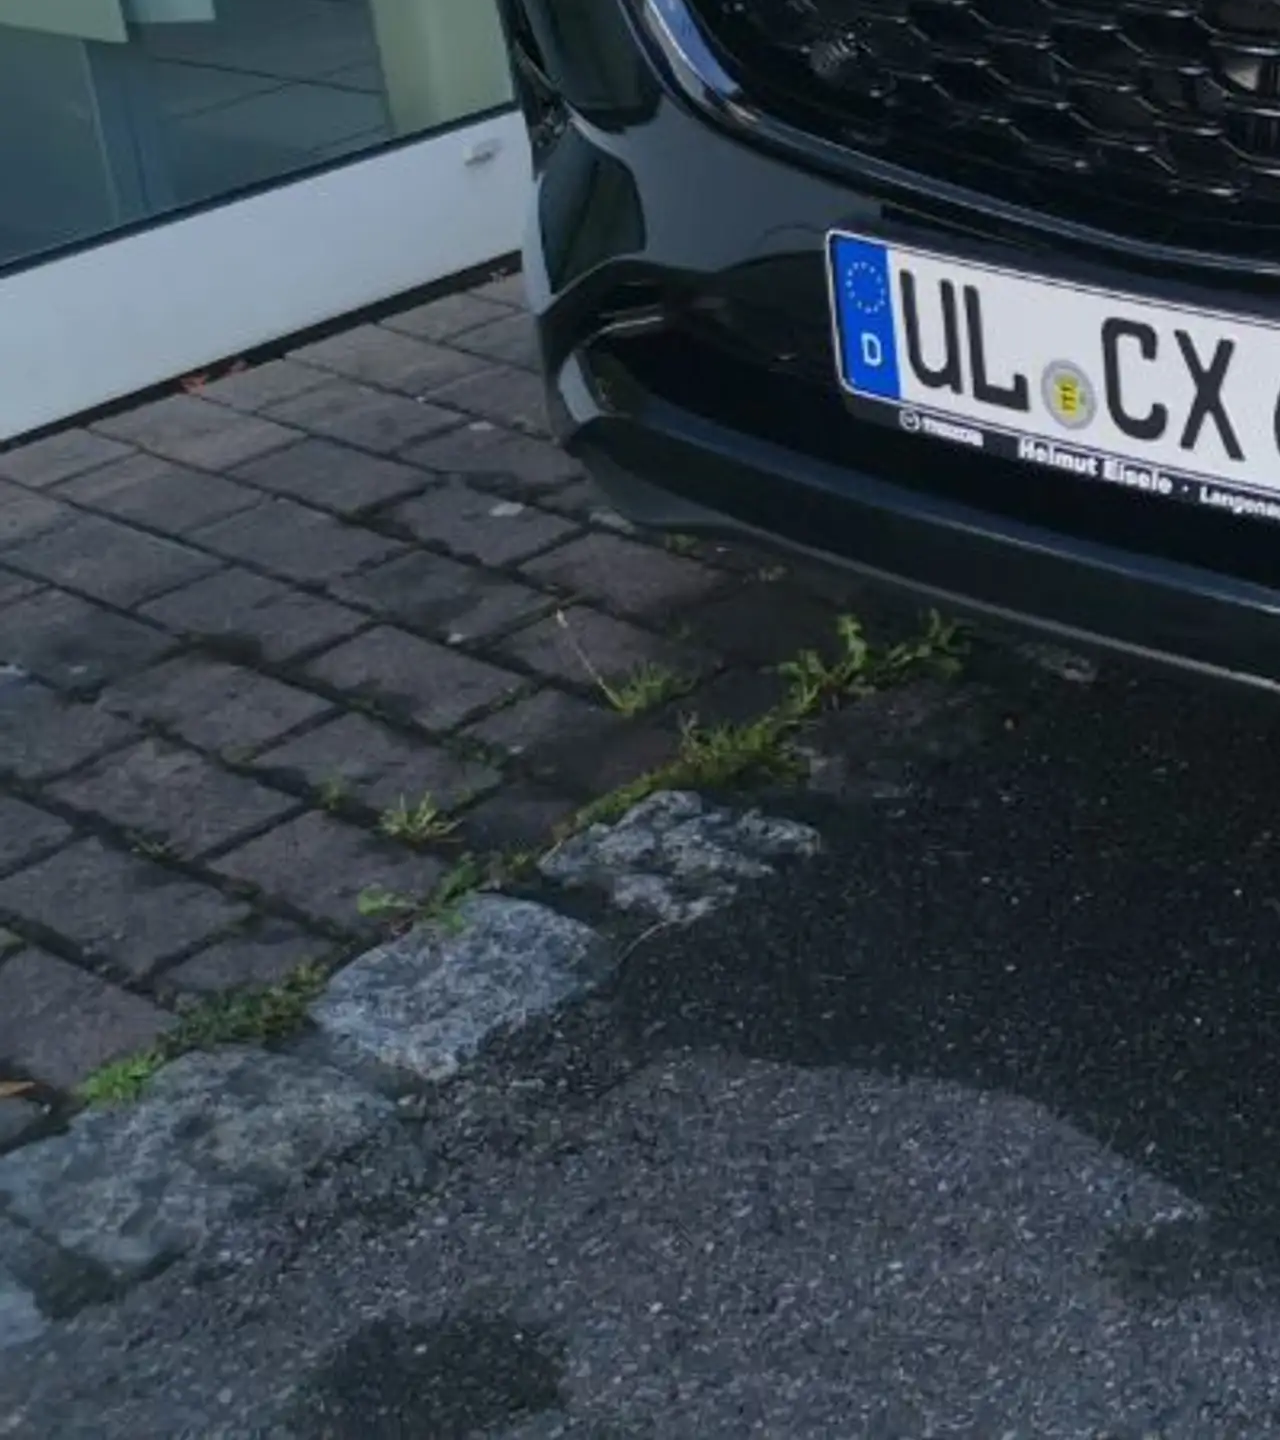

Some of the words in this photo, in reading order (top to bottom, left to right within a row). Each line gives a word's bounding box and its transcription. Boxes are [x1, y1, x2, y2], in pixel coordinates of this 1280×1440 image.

[862, 334, 881, 366] D
[900, 269, 1029, 411] UL
[1102, 317, 1245, 461] CX
[1018, 437, 1099, 476] Helmut
[1103, 459, 1174, 495] Eisele
